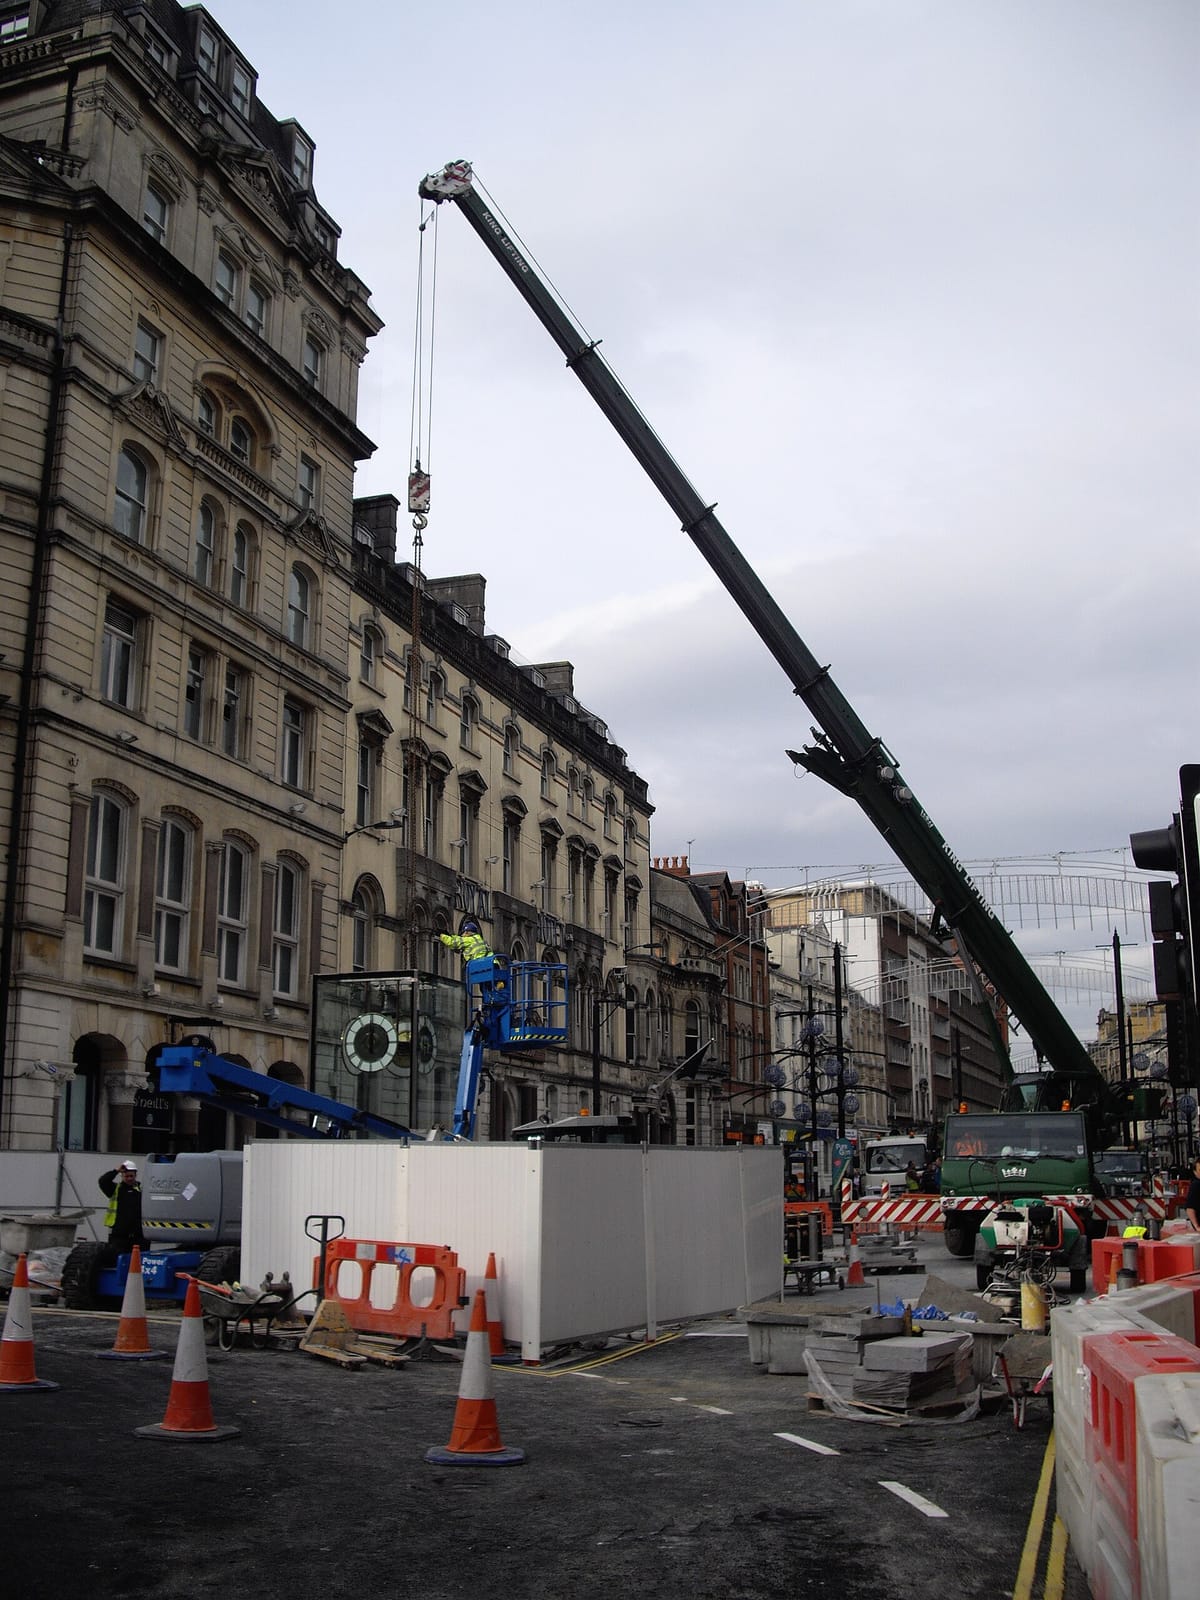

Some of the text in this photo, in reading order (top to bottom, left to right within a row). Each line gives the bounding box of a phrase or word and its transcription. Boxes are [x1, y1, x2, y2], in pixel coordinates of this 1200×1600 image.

[482, 211, 529, 273] KING LIFTING
[456, 877, 491, 918] ROYAL
[942, 842, 995, 920] KING LIFTING
[142, 1256, 164, 1266] Power
